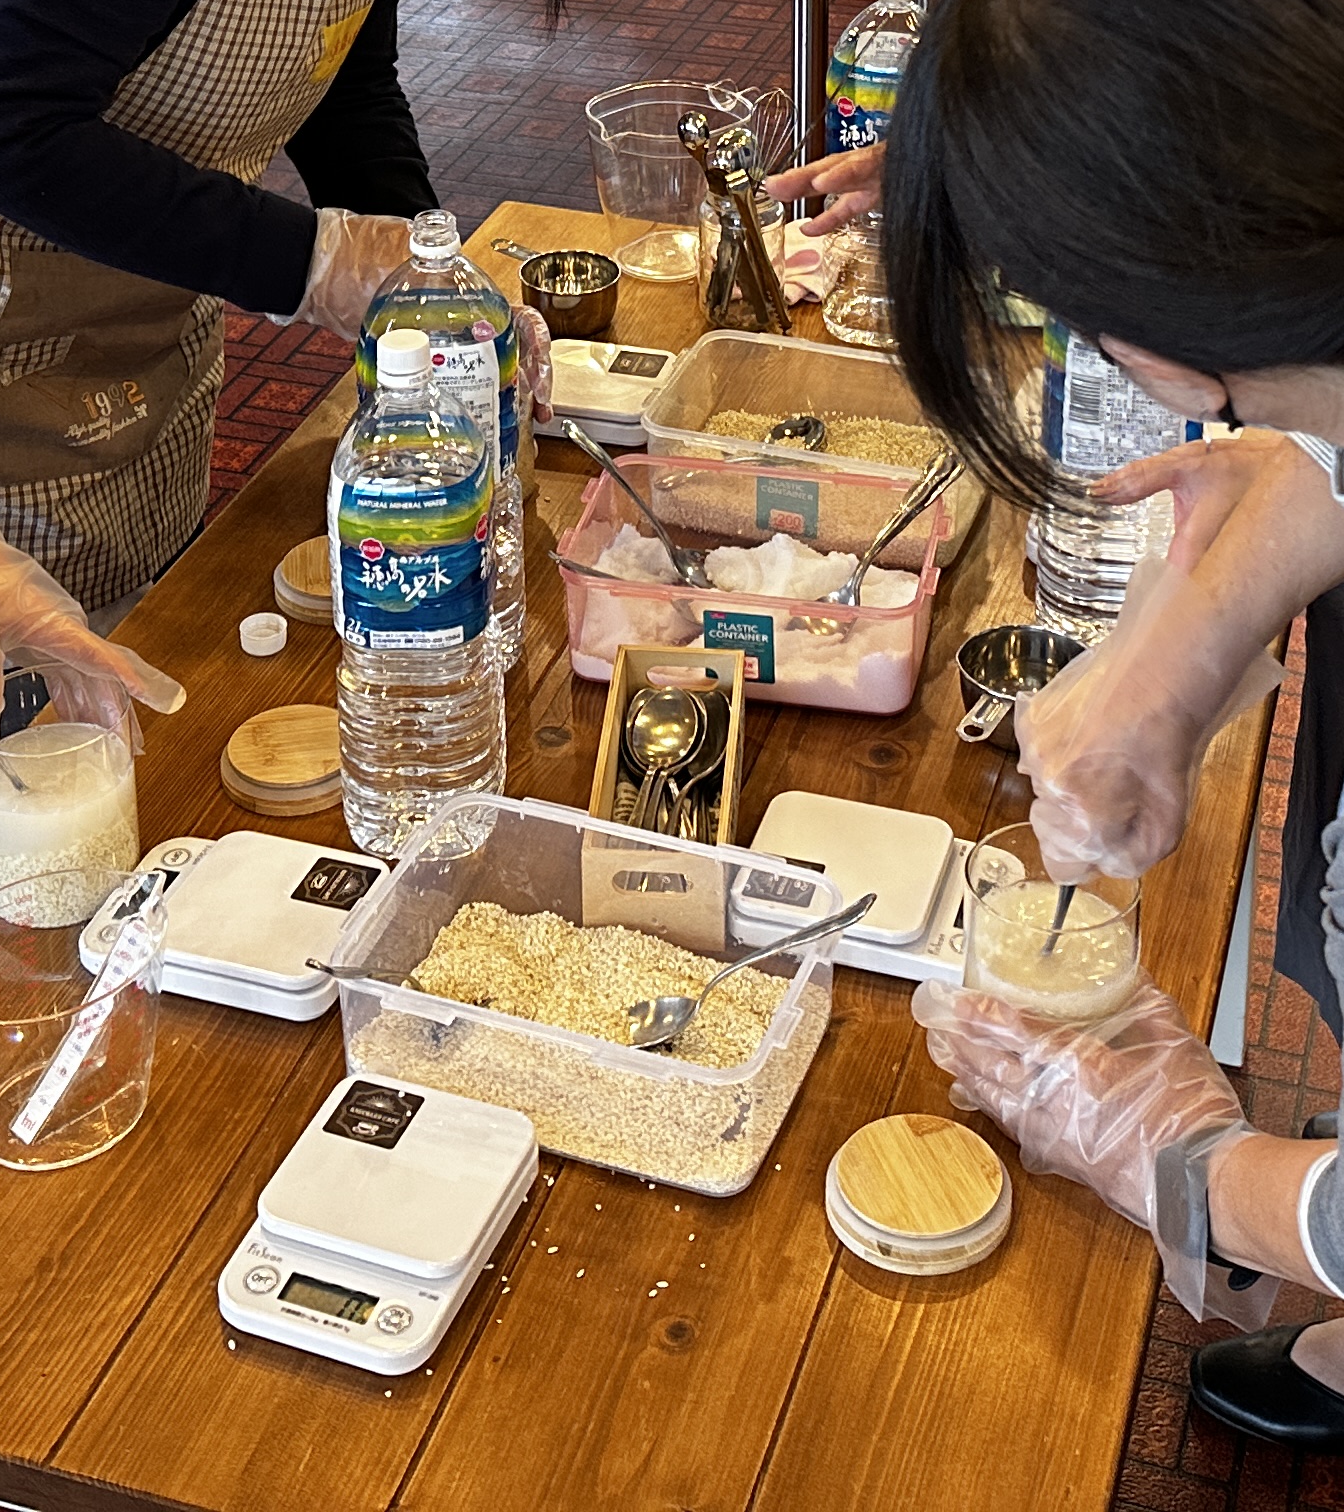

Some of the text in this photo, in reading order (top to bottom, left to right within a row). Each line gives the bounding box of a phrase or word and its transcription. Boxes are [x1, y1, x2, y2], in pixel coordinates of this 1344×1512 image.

[81, 381, 145, 418] 1992
[768, 479, 805, 492] PLASTIC
[760, 484, 813, 501] CONTAINER
[357, 499, 388, 509] NATURAL
[423, 498, 448, 508] WATER
[717, 622, 758, 633] PLASTIC
[708, 630, 769, 643] CONTAINER
